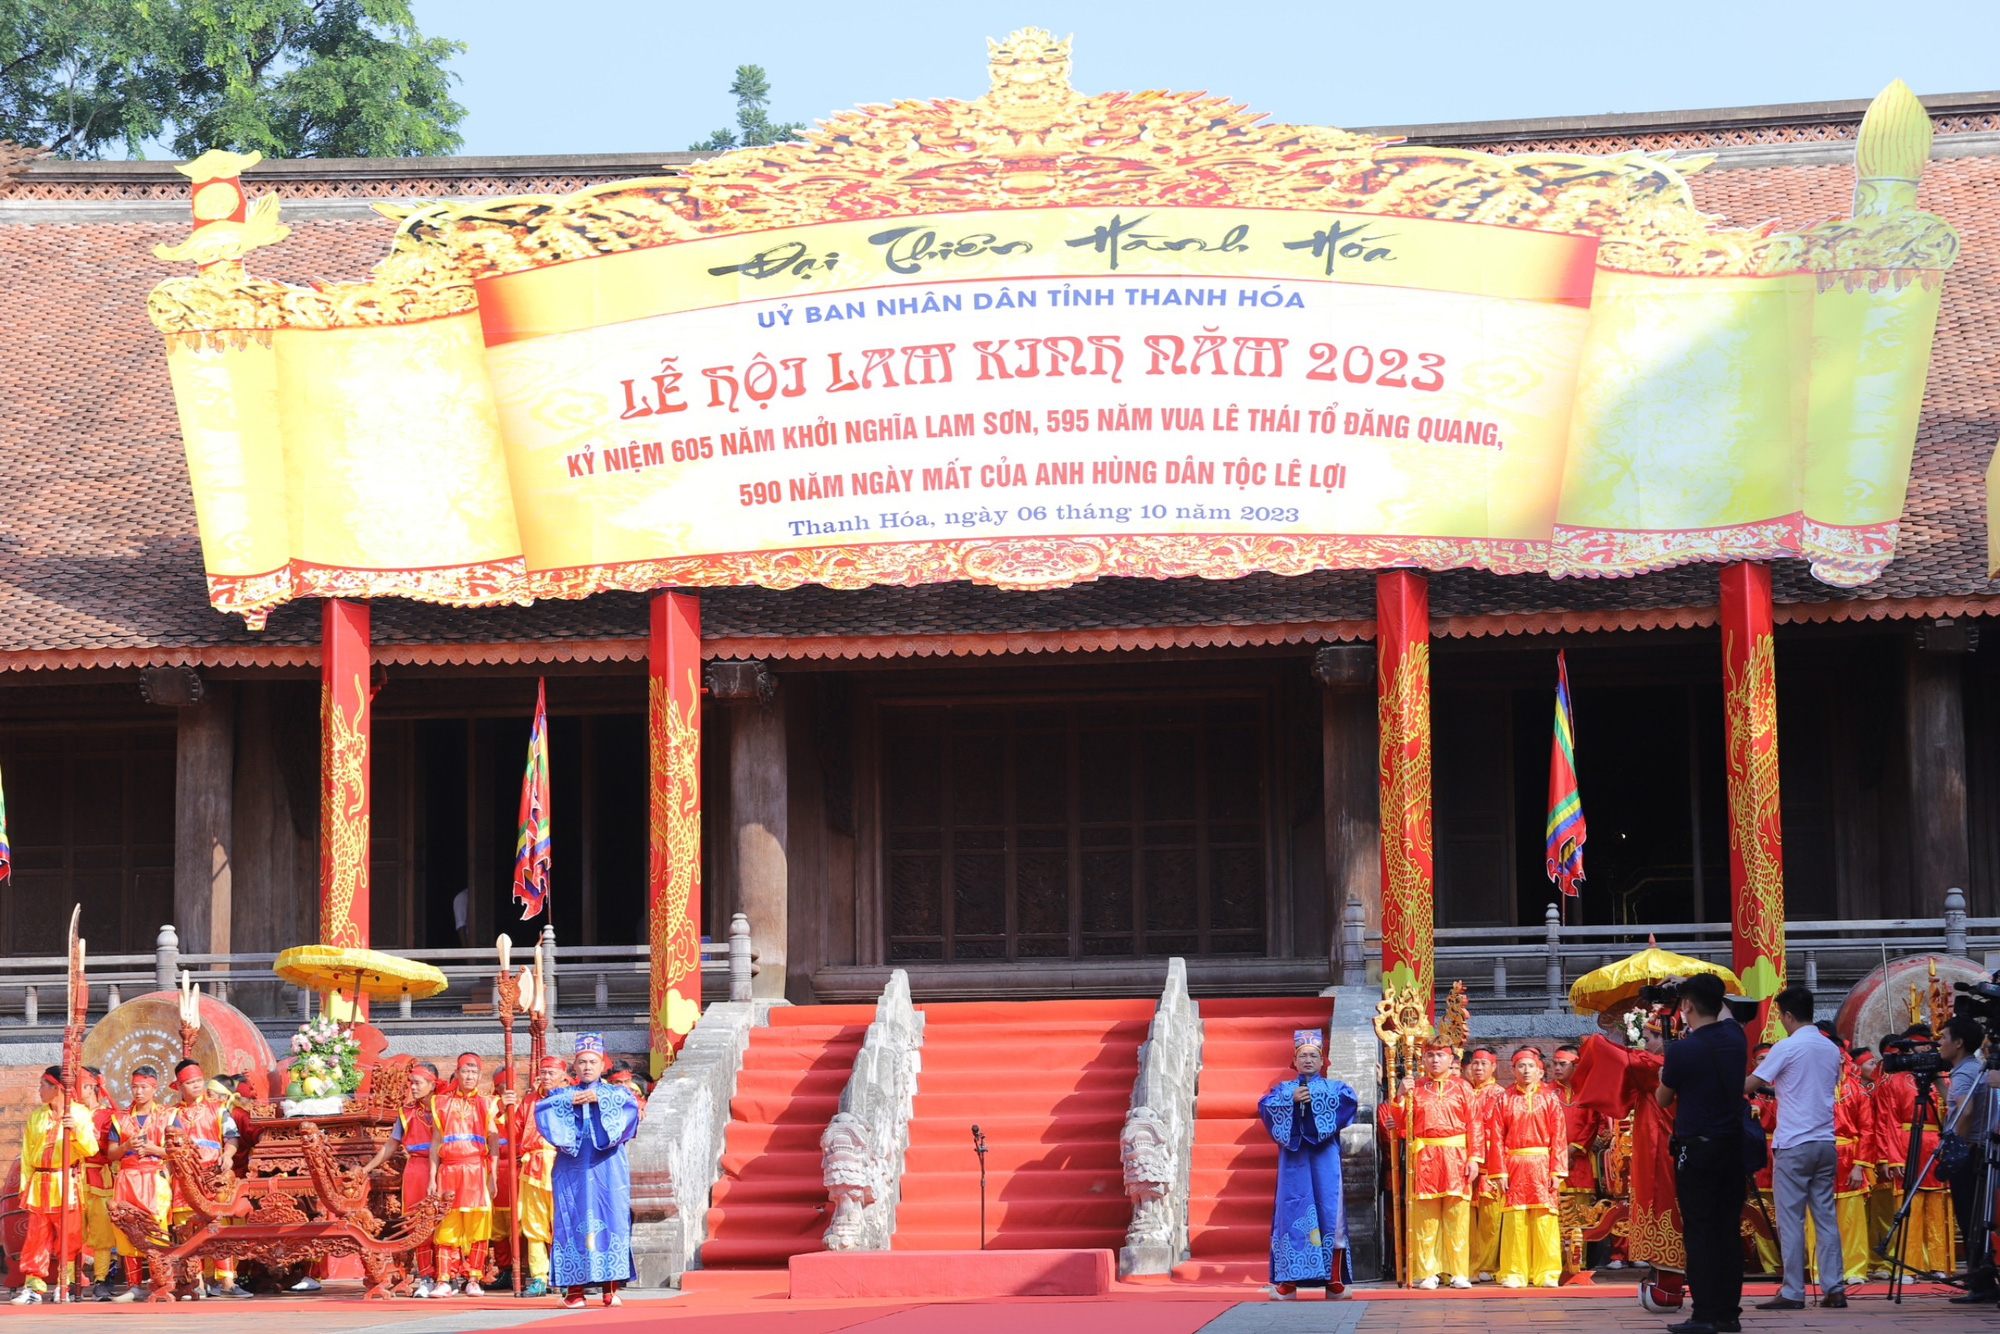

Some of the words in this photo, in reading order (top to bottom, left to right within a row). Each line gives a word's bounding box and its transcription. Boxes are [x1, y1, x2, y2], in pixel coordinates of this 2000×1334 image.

[805, 302, 866, 323] BAN
[877, 292, 962, 317] NHÂN
[973, 287, 1037, 311] DÂN
[1047, 284, 1115, 307] TỈNH
[1125, 288, 1227, 306] THANH
[1238, 284, 1305, 309] HÓA
[619, 356, 688, 420] LỄ
[701, 352, 808, 413] HỘI
[826, 342, 956, 393] LAM
[973, 335, 1124, 384] KINH
[1144, 326, 1289, 378] NĂM
[1306, 342, 1445, 392] 2023
[567, 444, 596, 478] KỶ
[603, 440, 665, 473] NIỆM
[671, 436, 714, 463] 605
[719, 426, 775, 456] NĂM
[782, 415, 838, 449] KHỞI
[844, 412, 918, 444] NGHĨA
[925, 413, 975, 438] LAM
[983, 409, 1040, 435] SƠN,
[1047, 409, 1089, 433] 595
[1098, 404, 1153, 431] NĂM
[1161, 407, 1204, 431] VUA
[1213, 403, 1239, 432] LÊ
[1247, 404, 1300, 433] THÁI
[1309, 402, 1337, 434] TỔ
[1343, 408, 1410, 439] ĐĂNG
[1418, 416, 1504, 451] QUANG,
[739, 480, 782, 507] 590
[789, 472, 844, 501] NĂM
[851, 465, 914, 497] NGÀY
[922, 458, 972, 491] MẤT
[980, 456, 1028, 488] CỦA
[1035, 462, 1084, 486] ANH
[1092, 456, 1157, 485] HÙNG
[1165, 458, 1214, 485] DÂN
[1223, 458, 1267, 491] TỘC
[1274, 459, 1302, 487] LÊ
[1309, 463, 1346, 494] LỢI
[788, 515, 871, 537] Thanh
[879, 510, 936, 529] Hóa,
[944, 504, 1006, 530] ngày
[1016, 507, 1048, 521] 06
[1056, 503, 1132, 524] tháng
[1140, 505, 1168, 520] 10
[1175, 505, 1231, 521] năm
[1240, 506, 1300, 523] 2023
